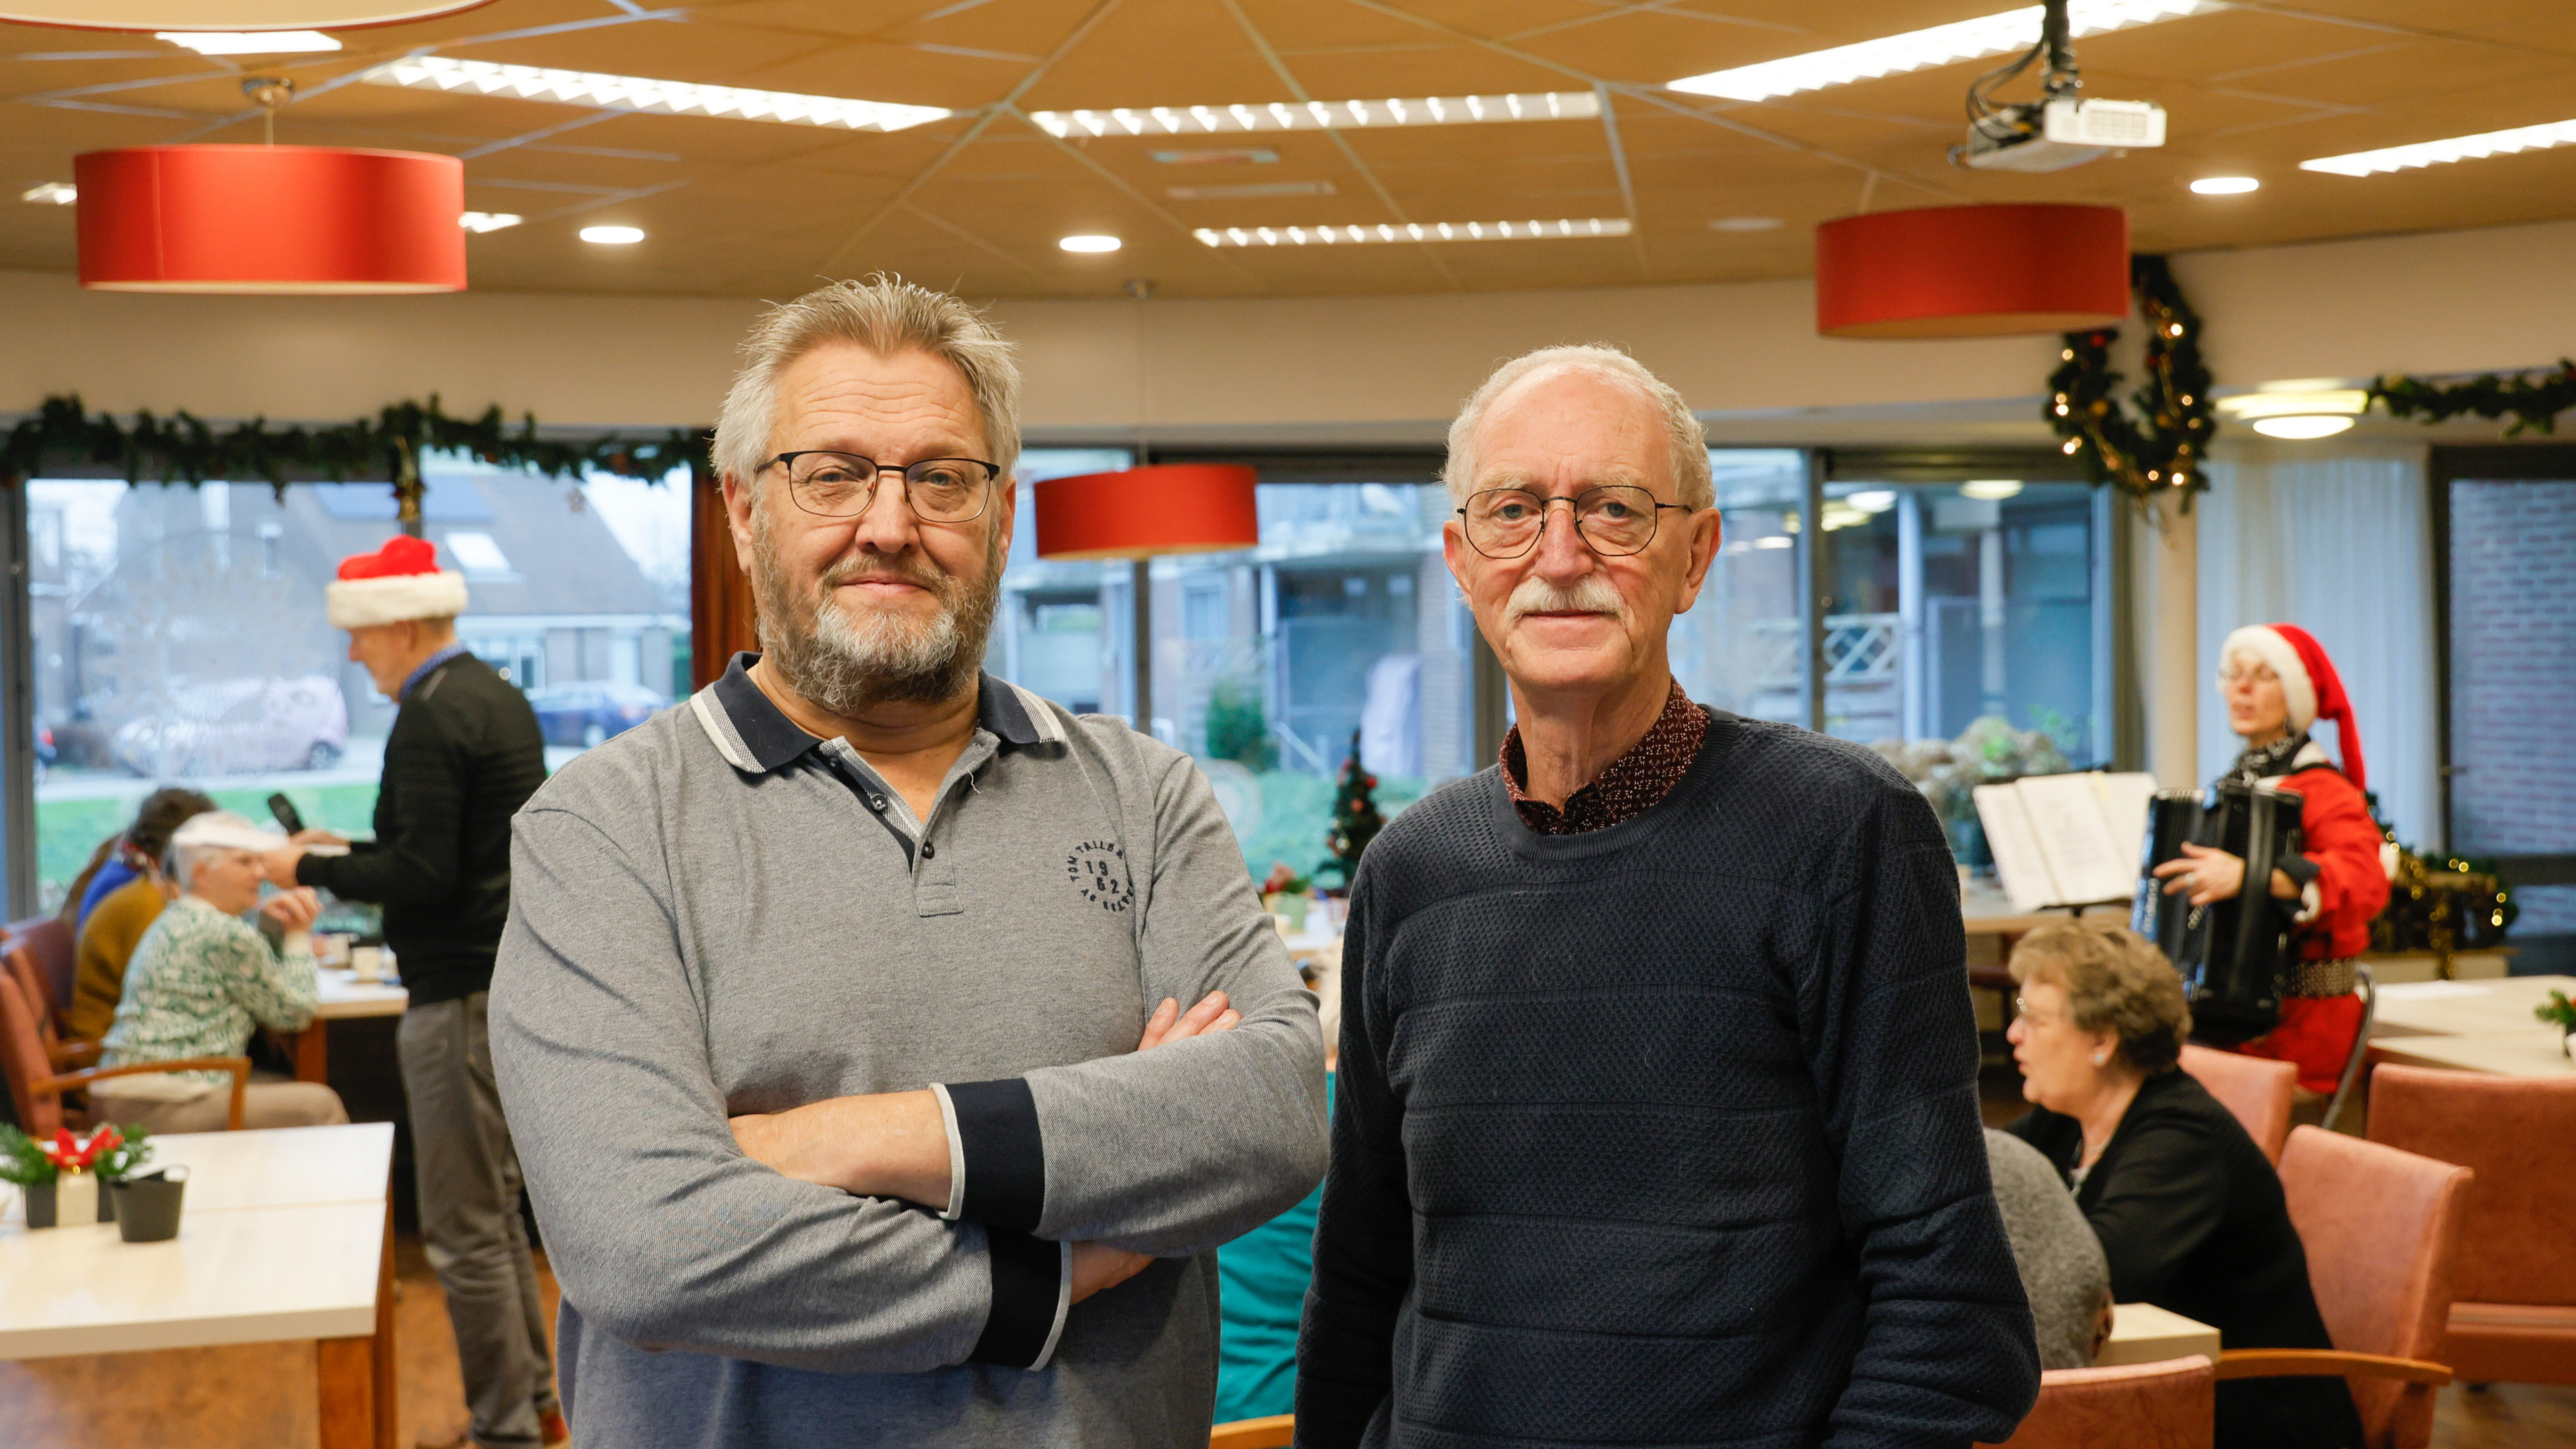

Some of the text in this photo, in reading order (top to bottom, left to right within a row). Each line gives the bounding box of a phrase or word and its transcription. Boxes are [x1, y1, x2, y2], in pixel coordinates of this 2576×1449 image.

[1067, 855, 1079, 882] TOM
[1085, 860, 1108, 876] 19
[1096, 877, 1120, 894] 62
